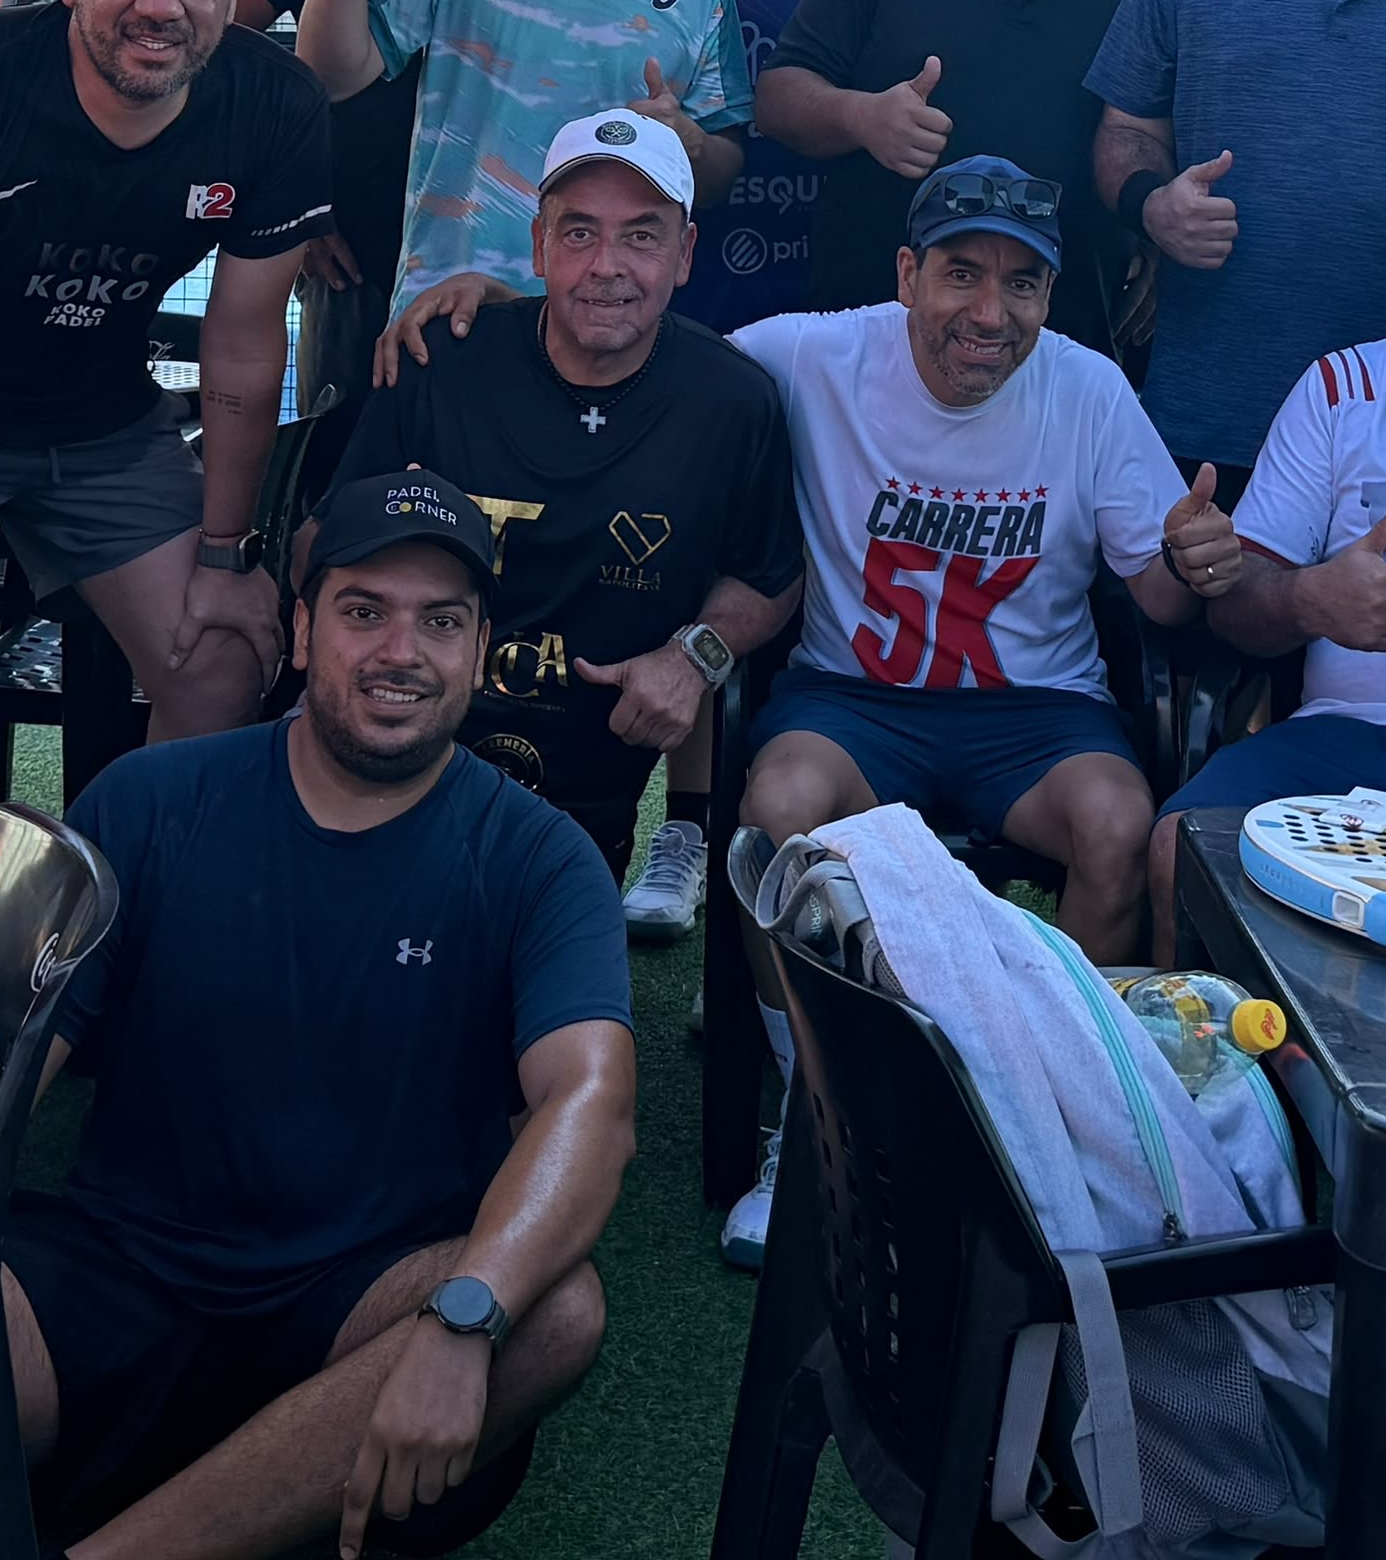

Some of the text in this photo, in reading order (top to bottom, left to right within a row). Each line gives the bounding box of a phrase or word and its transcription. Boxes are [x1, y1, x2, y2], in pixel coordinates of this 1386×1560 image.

[185, 182, 236, 220] R2
[24, 274, 150, 304] KOKO
[387, 486, 440, 503] PADEL
[866, 490, 1046, 557] CARRERA
[851, 536, 1042, 688] 5K
